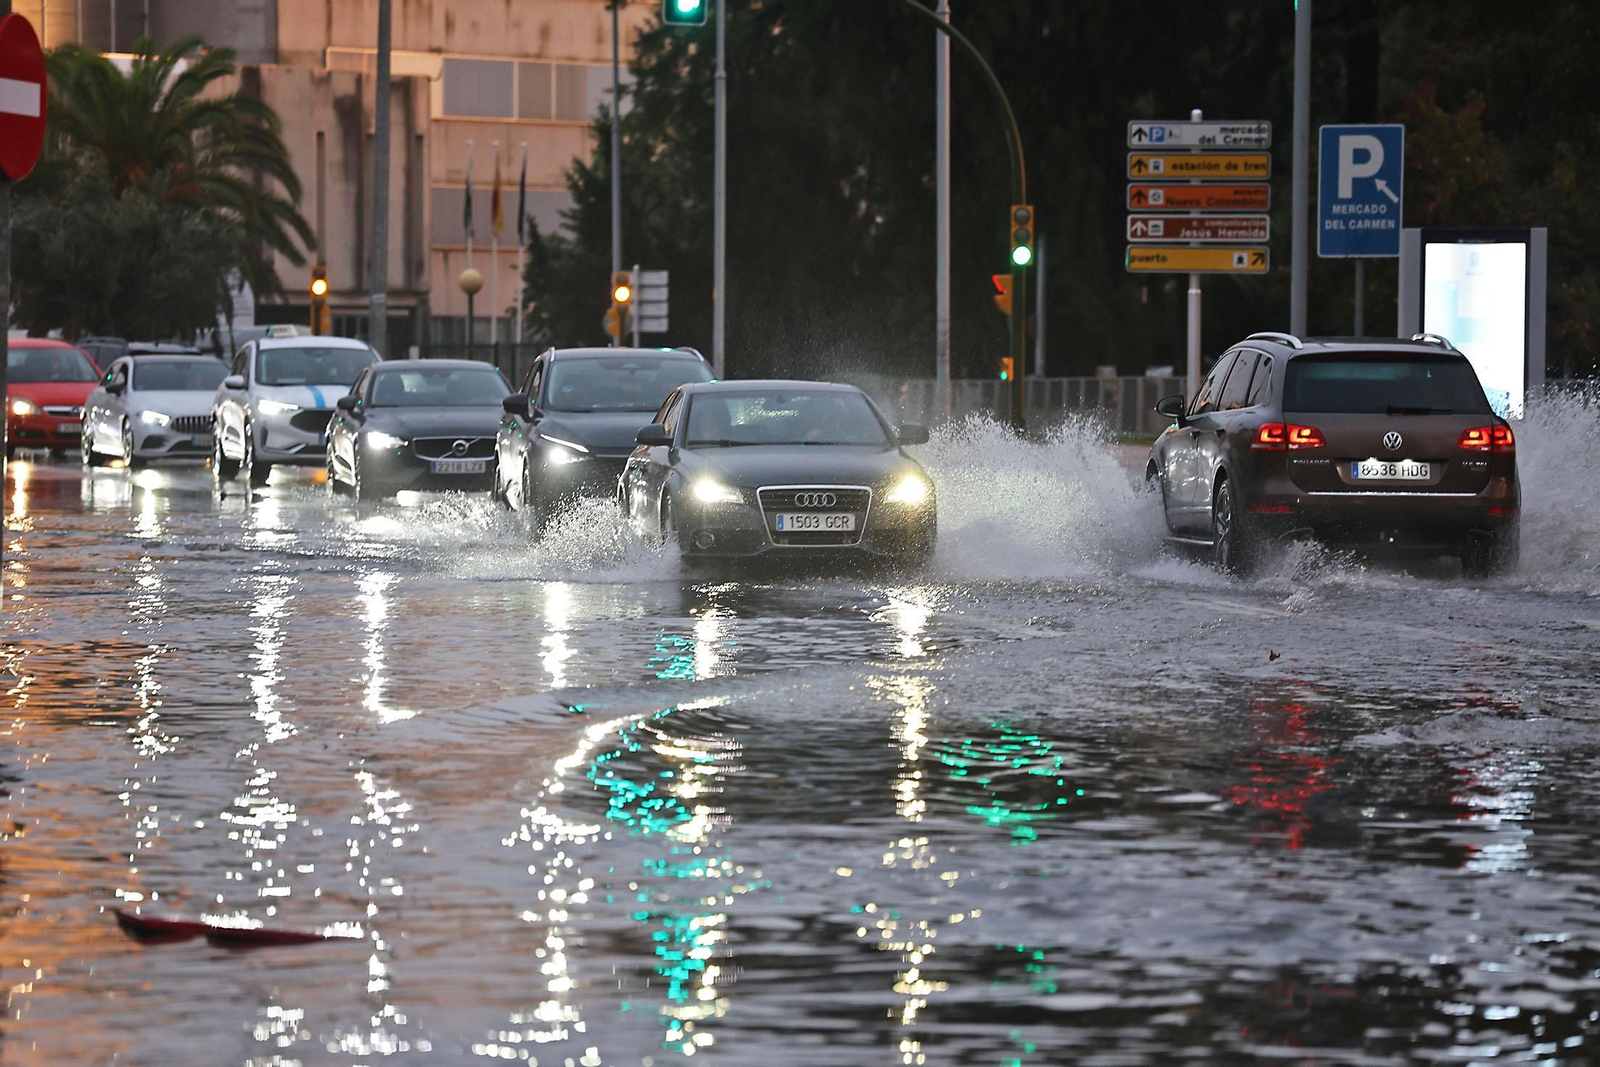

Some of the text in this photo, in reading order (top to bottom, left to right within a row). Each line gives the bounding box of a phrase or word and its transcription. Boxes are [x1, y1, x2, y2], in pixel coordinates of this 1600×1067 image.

[1219, 125, 1267, 135] mercado
[1199, 135, 1266, 145] del Carmen
[1172, 160, 1267, 171] estación de tren
[1338, 135, 1385, 199] P
[1166, 196, 1201, 206] Nuevo
[1332, 204, 1388, 214] MERCADO
[1325, 219, 1396, 230] DEL CARMEN
[1179, 227, 1266, 238] Jesús Hermida
[1130, 254, 1168, 264] puerto
[1361, 463, 1428, 477] 8536 HDG
[789, 515, 850, 529] 1503 GCR
